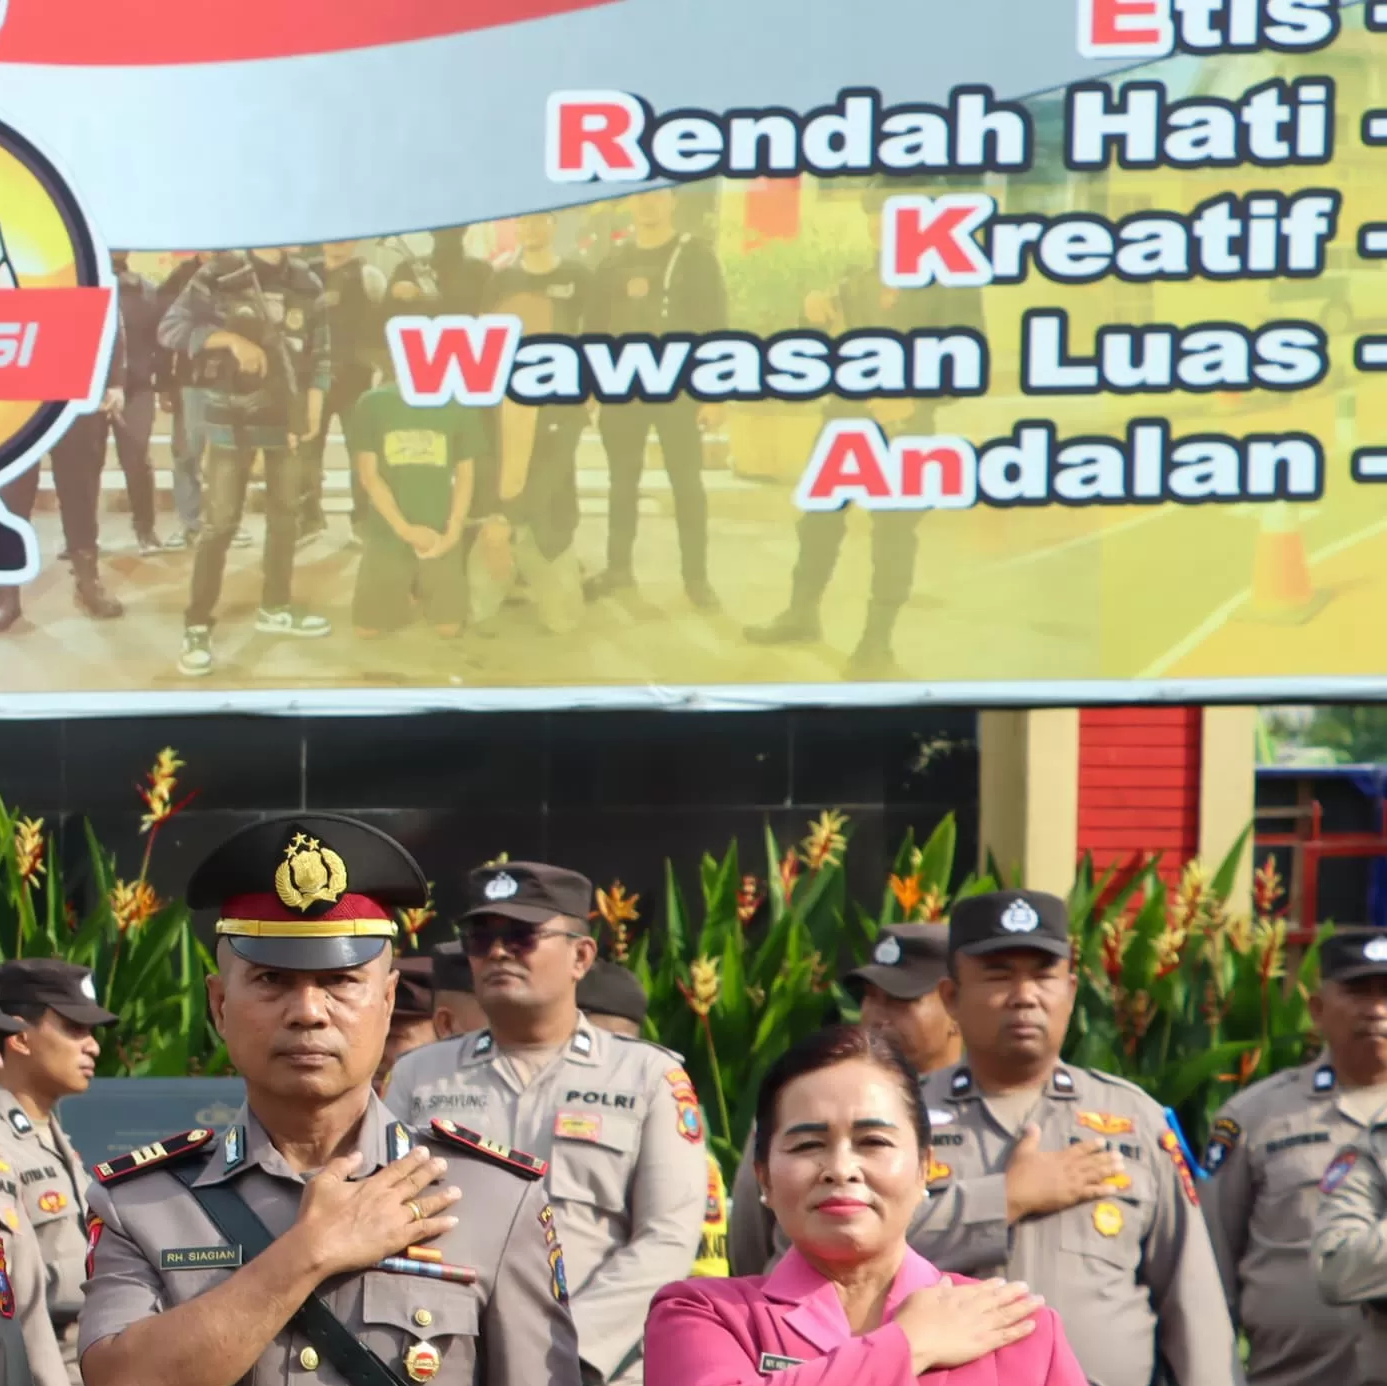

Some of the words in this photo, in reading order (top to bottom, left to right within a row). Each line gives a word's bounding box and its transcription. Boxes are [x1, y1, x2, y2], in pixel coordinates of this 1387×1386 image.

[1089, 0, 1334, 46] Etis
[555, 94, 1026, 173] Rendah
[1071, 84, 1327, 163] Hati
[892, 195, 1335, 277] Kreatif
[397, 326, 983, 397] Wawasan
[1027, 315, 1322, 387] Luas
[805, 425, 1317, 501] Andalan
[565, 1090, 637, 1110] POLRI
[188, 1250, 236, 1262] SIAGIAN
